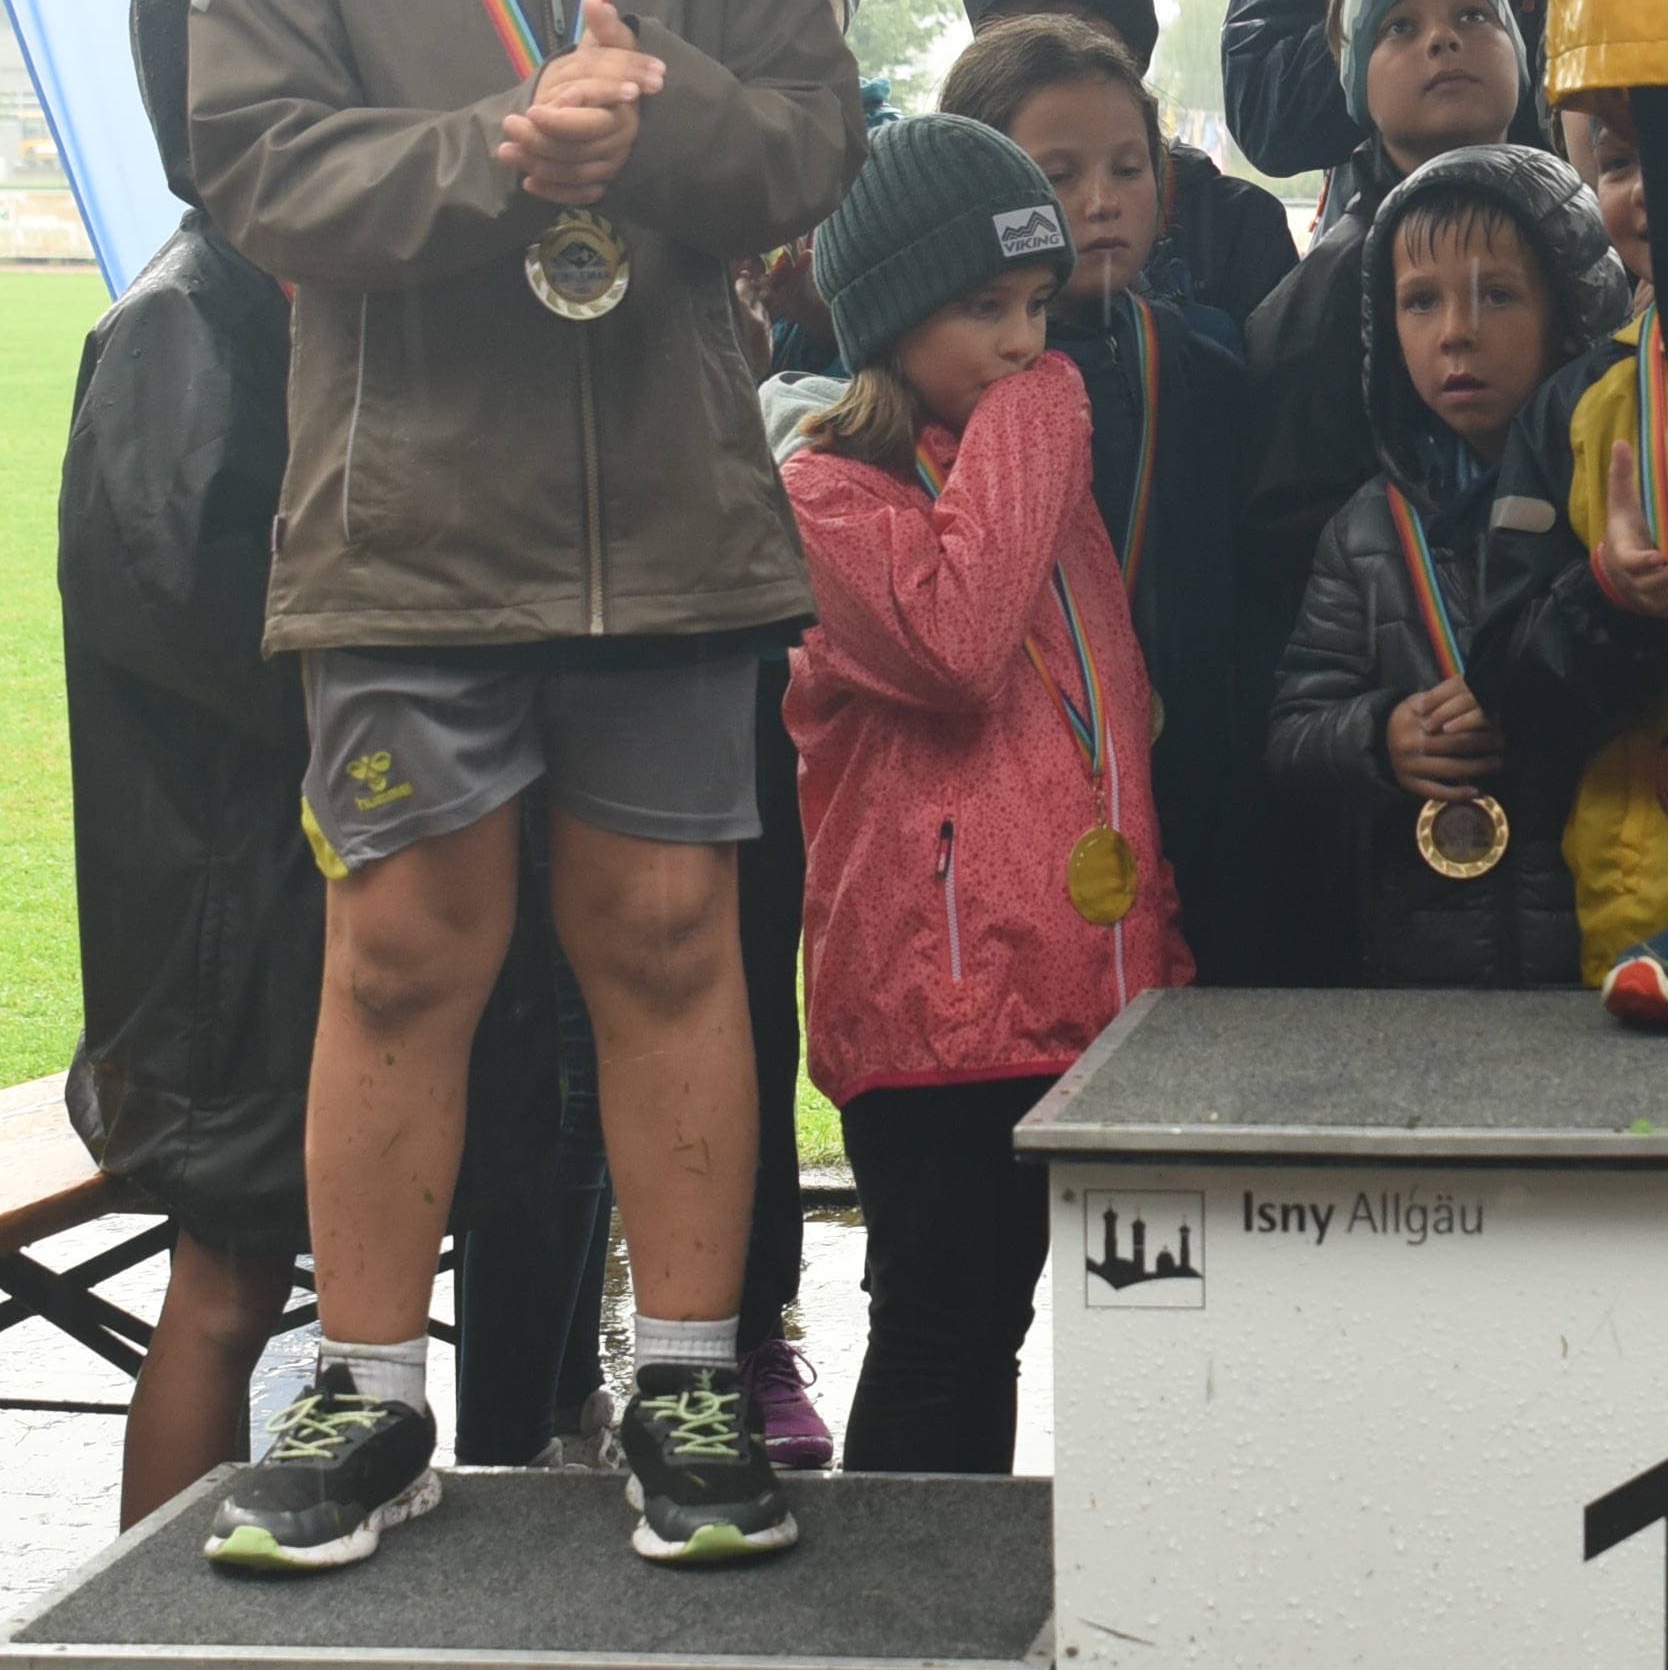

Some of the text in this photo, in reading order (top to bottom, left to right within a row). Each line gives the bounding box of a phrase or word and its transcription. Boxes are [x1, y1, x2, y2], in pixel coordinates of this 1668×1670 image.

[1003, 233, 1061, 253] VIKING
[1243, 1189, 1484, 1246] Isny Allgäu
